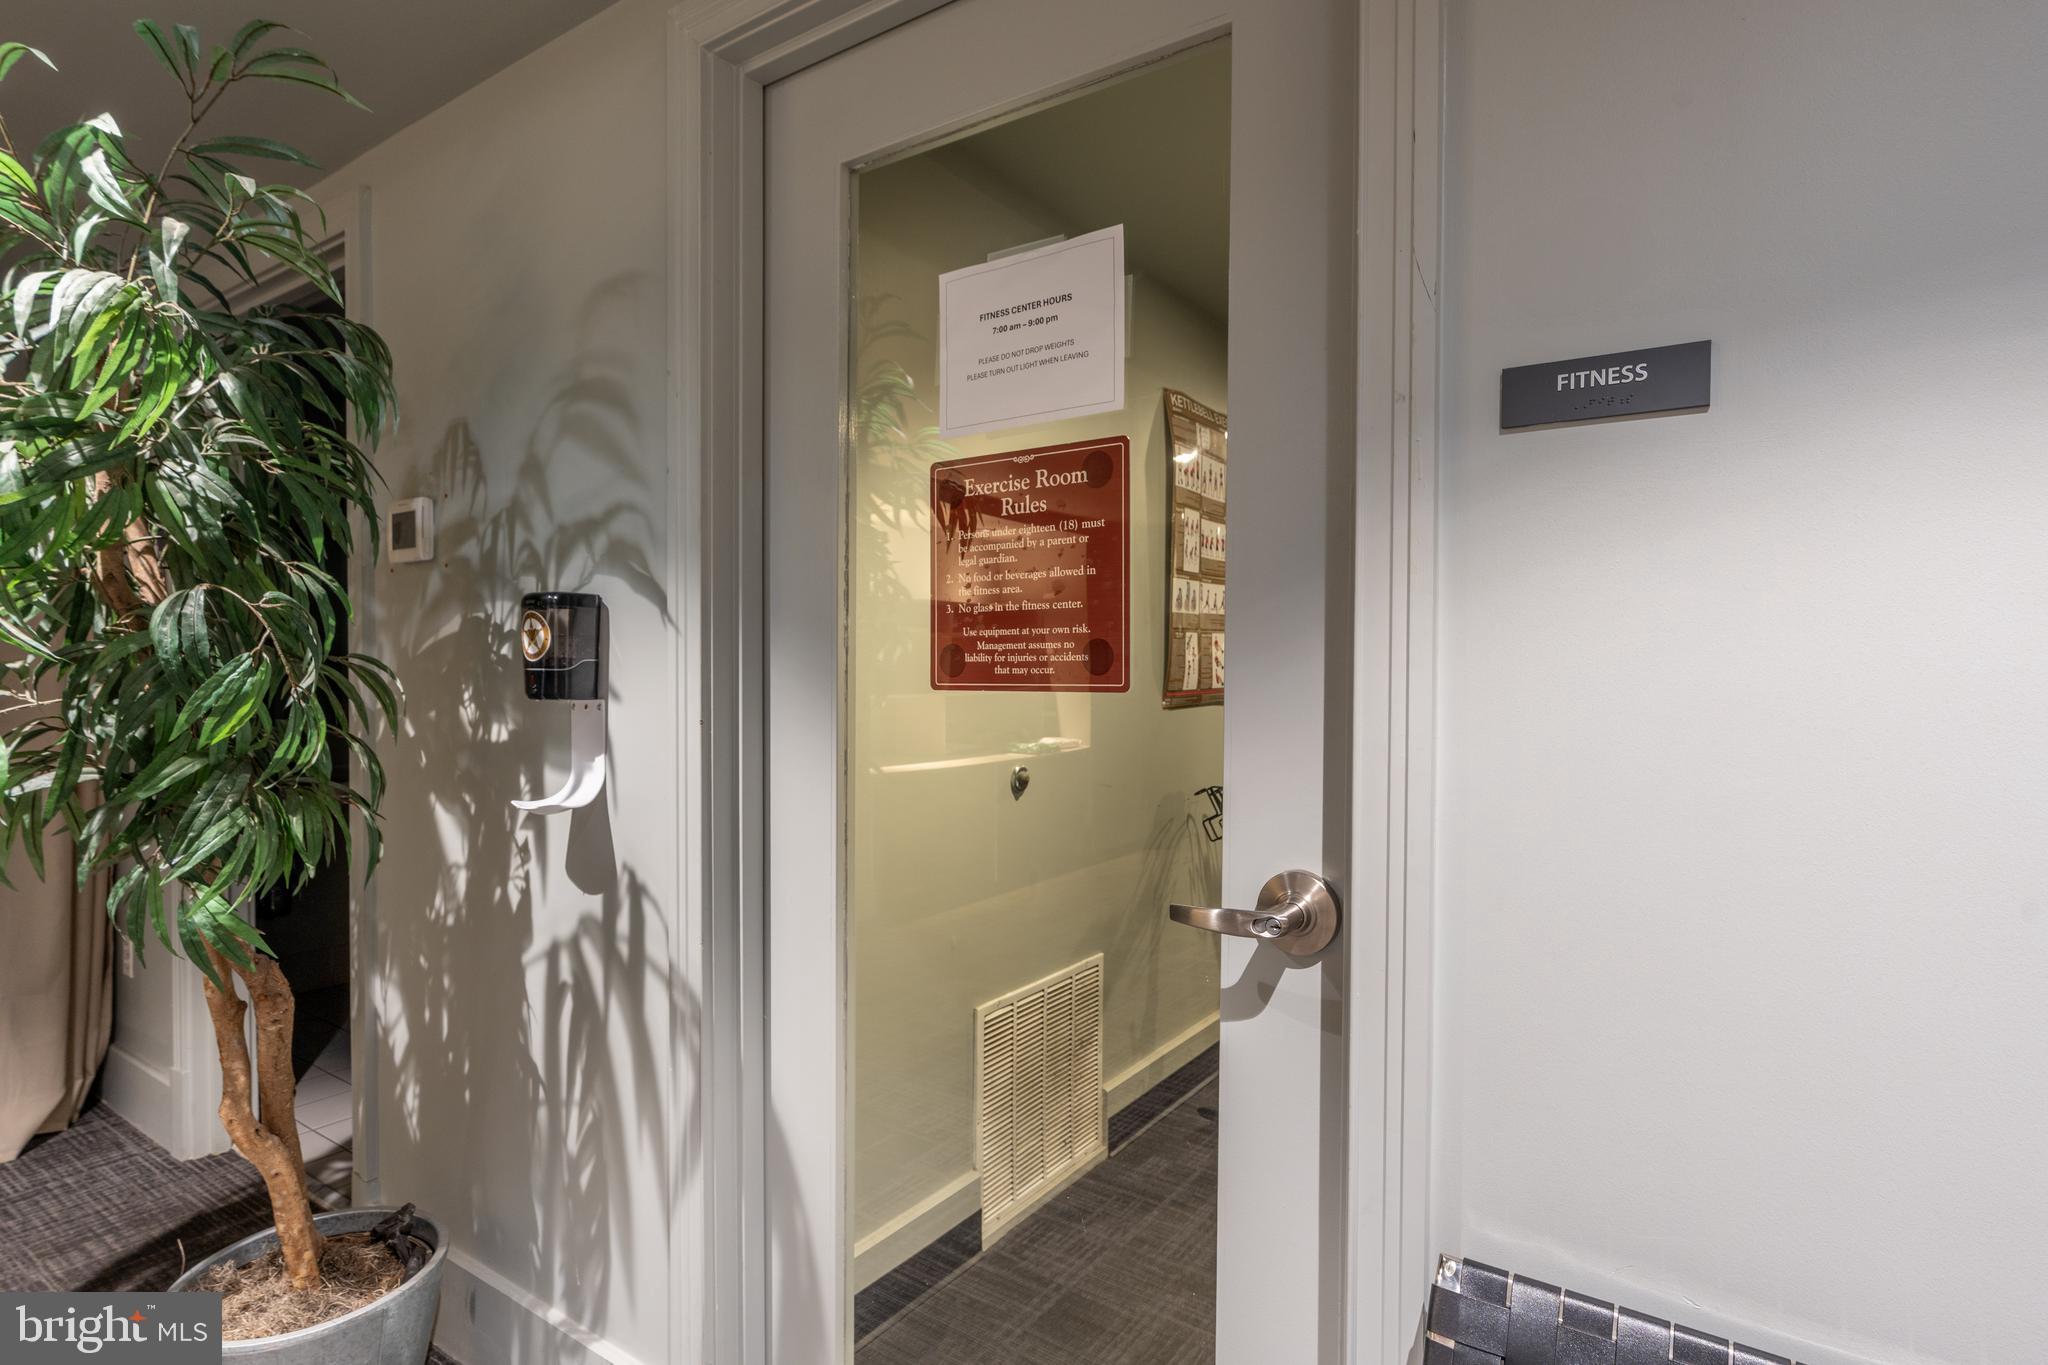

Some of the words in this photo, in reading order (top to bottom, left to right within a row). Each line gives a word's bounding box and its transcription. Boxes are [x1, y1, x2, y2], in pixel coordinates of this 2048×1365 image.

[980, 308, 1010, 322] FITNESS
[1011, 300, 1042, 315] CENTER
[1043, 293, 1072, 306] HOURS
[993, 326, 1008, 334] 7:00
[1009, 323, 1021, 331] am
[1028, 318, 1044, 327] 9:00
[1046, 314, 1058, 327] pm
[978, 354, 1000, 365] PLEASE
[1001, 351, 1010, 360] DO
[1011, 350, 1024, 358] NOT
[1025, 345, 1043, 355] DROP
[1044, 339, 1075, 350] WEIGHTS
[967, 371, 988, 382] PLEASE
[989, 368, 1006, 377] TURN
[1006, 365, 1019, 373] OUT
[1020, 361, 1038, 371] LIGHT
[1039, 357, 1059, 367] WHEN
[1060, 350, 1089, 362] LEAVING
[1557, 363, 1648, 391] FITNESS
[964, 475, 1030, 496] Exercise
[1036, 470, 1088, 488] Room
[1001, 495, 1047, 516] Rules
[958, 529, 990, 540] Persons
[992, 526, 1016, 537] under
[1018, 523, 1056, 537] eighteen
[1059, 520, 1078, 531] (18)
[1082, 518, 1105, 528] must
[958, 544, 968, 552] be
[970, 540, 1025, 553] accompanied
[1027, 539, 1037, 549] by
[1047, 537, 1076, 548] parent
[958, 557, 977, 567] legal
[978, 555, 1018, 566] guardian.
[946, 575, 953, 584] 2.
[958, 574, 971, 583] No
[973, 573, 991, 582] food
[1005, 571, 1046, 580] beverages
[1049, 568, 1084, 577] allowed
[1087, 566, 1096, 575] in
[958, 587, 973, 596] the
[974, 586, 1000, 595] fitness
[946, 605, 954, 614] 3.
[958, 604, 971, 613] No
[973, 604, 992, 615] glass
[994, 603, 1004, 612] in
[1006, 602, 1020, 611] the
[1022, 601, 1050, 610] fitness
[1052, 600, 1083, 609] center.
[963, 627, 977, 637] Use
[979, 627, 1019, 637] equipment
[1021, 627, 1029, 635] at
[1031, 627, 1050, 636] your
[1072, 624, 1091, 633] risk.
[977, 641, 1026, 651] Management
[965, 653, 992, 664] liability
[994, 654, 1005, 662] for
[1007, 653, 1037, 663] injuries
[1050, 652, 1088, 661] accidents
[994, 666, 1010, 674] that
[1012, 667, 1028, 676] may
[1030, 666, 1055, 674] occur.
